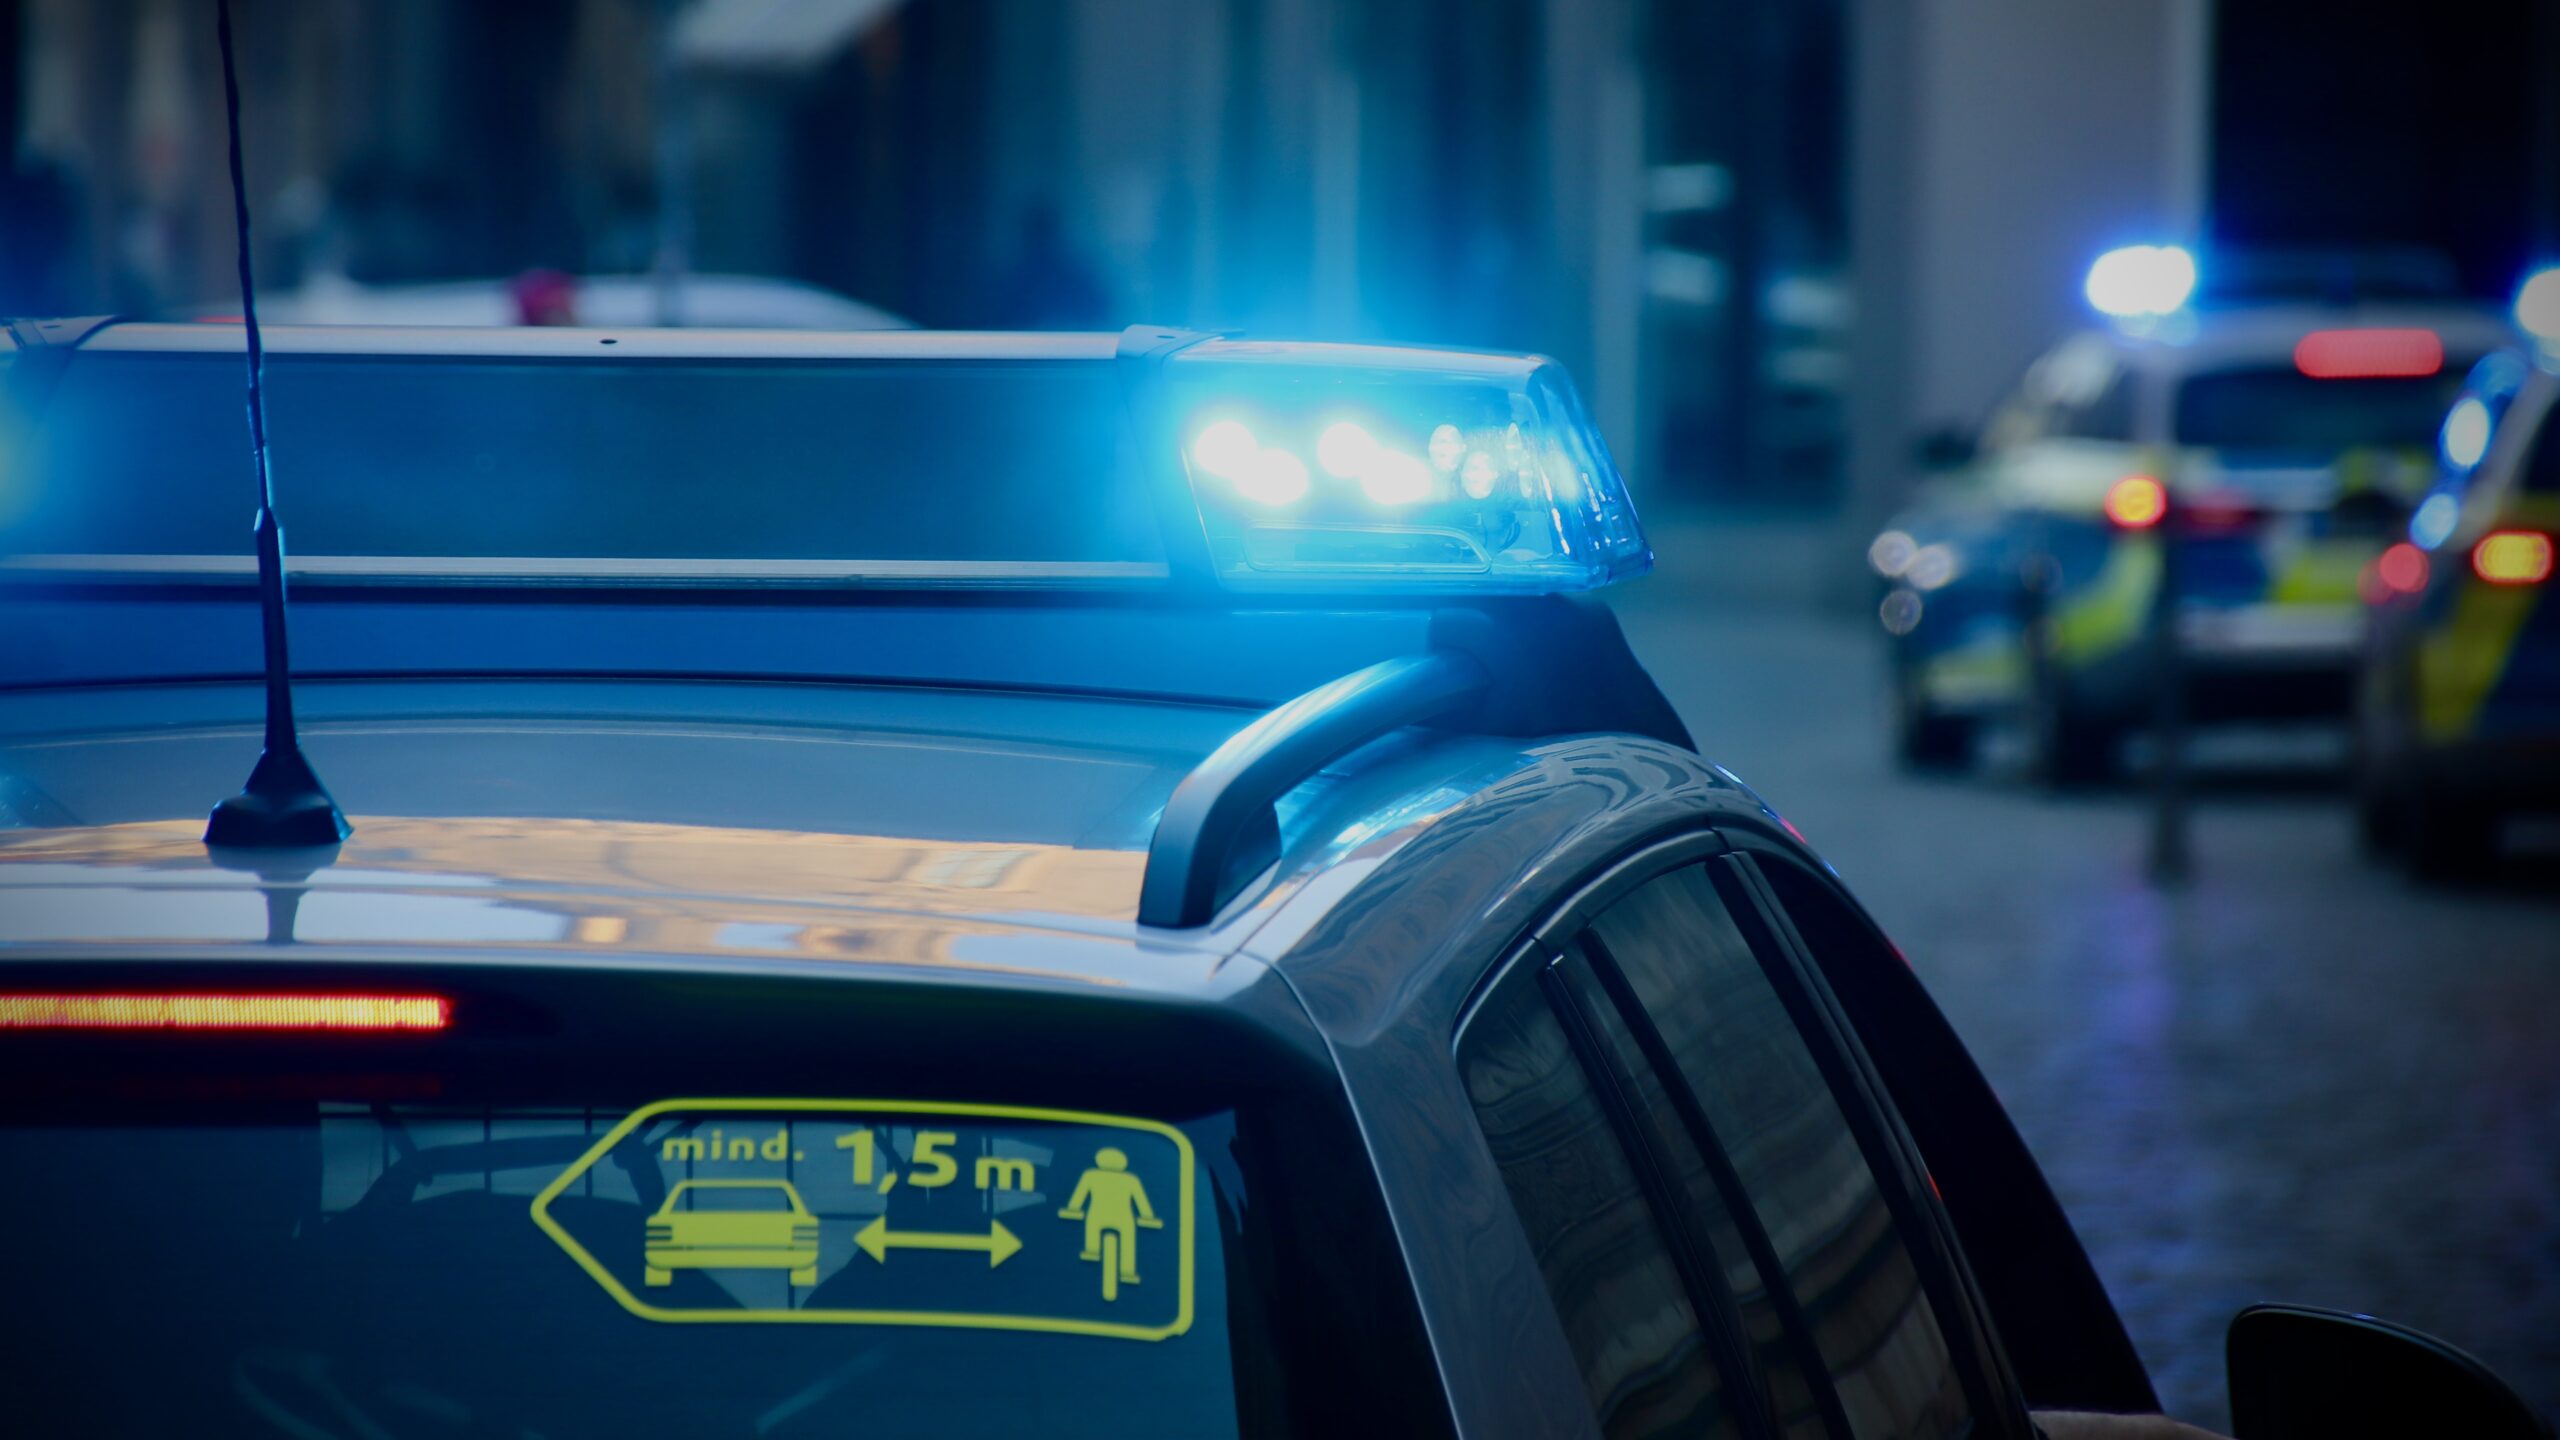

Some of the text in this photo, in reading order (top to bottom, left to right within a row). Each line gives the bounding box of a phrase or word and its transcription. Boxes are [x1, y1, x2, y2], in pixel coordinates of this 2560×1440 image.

[662, 1130, 1035, 1195] mind. 1,5 m
